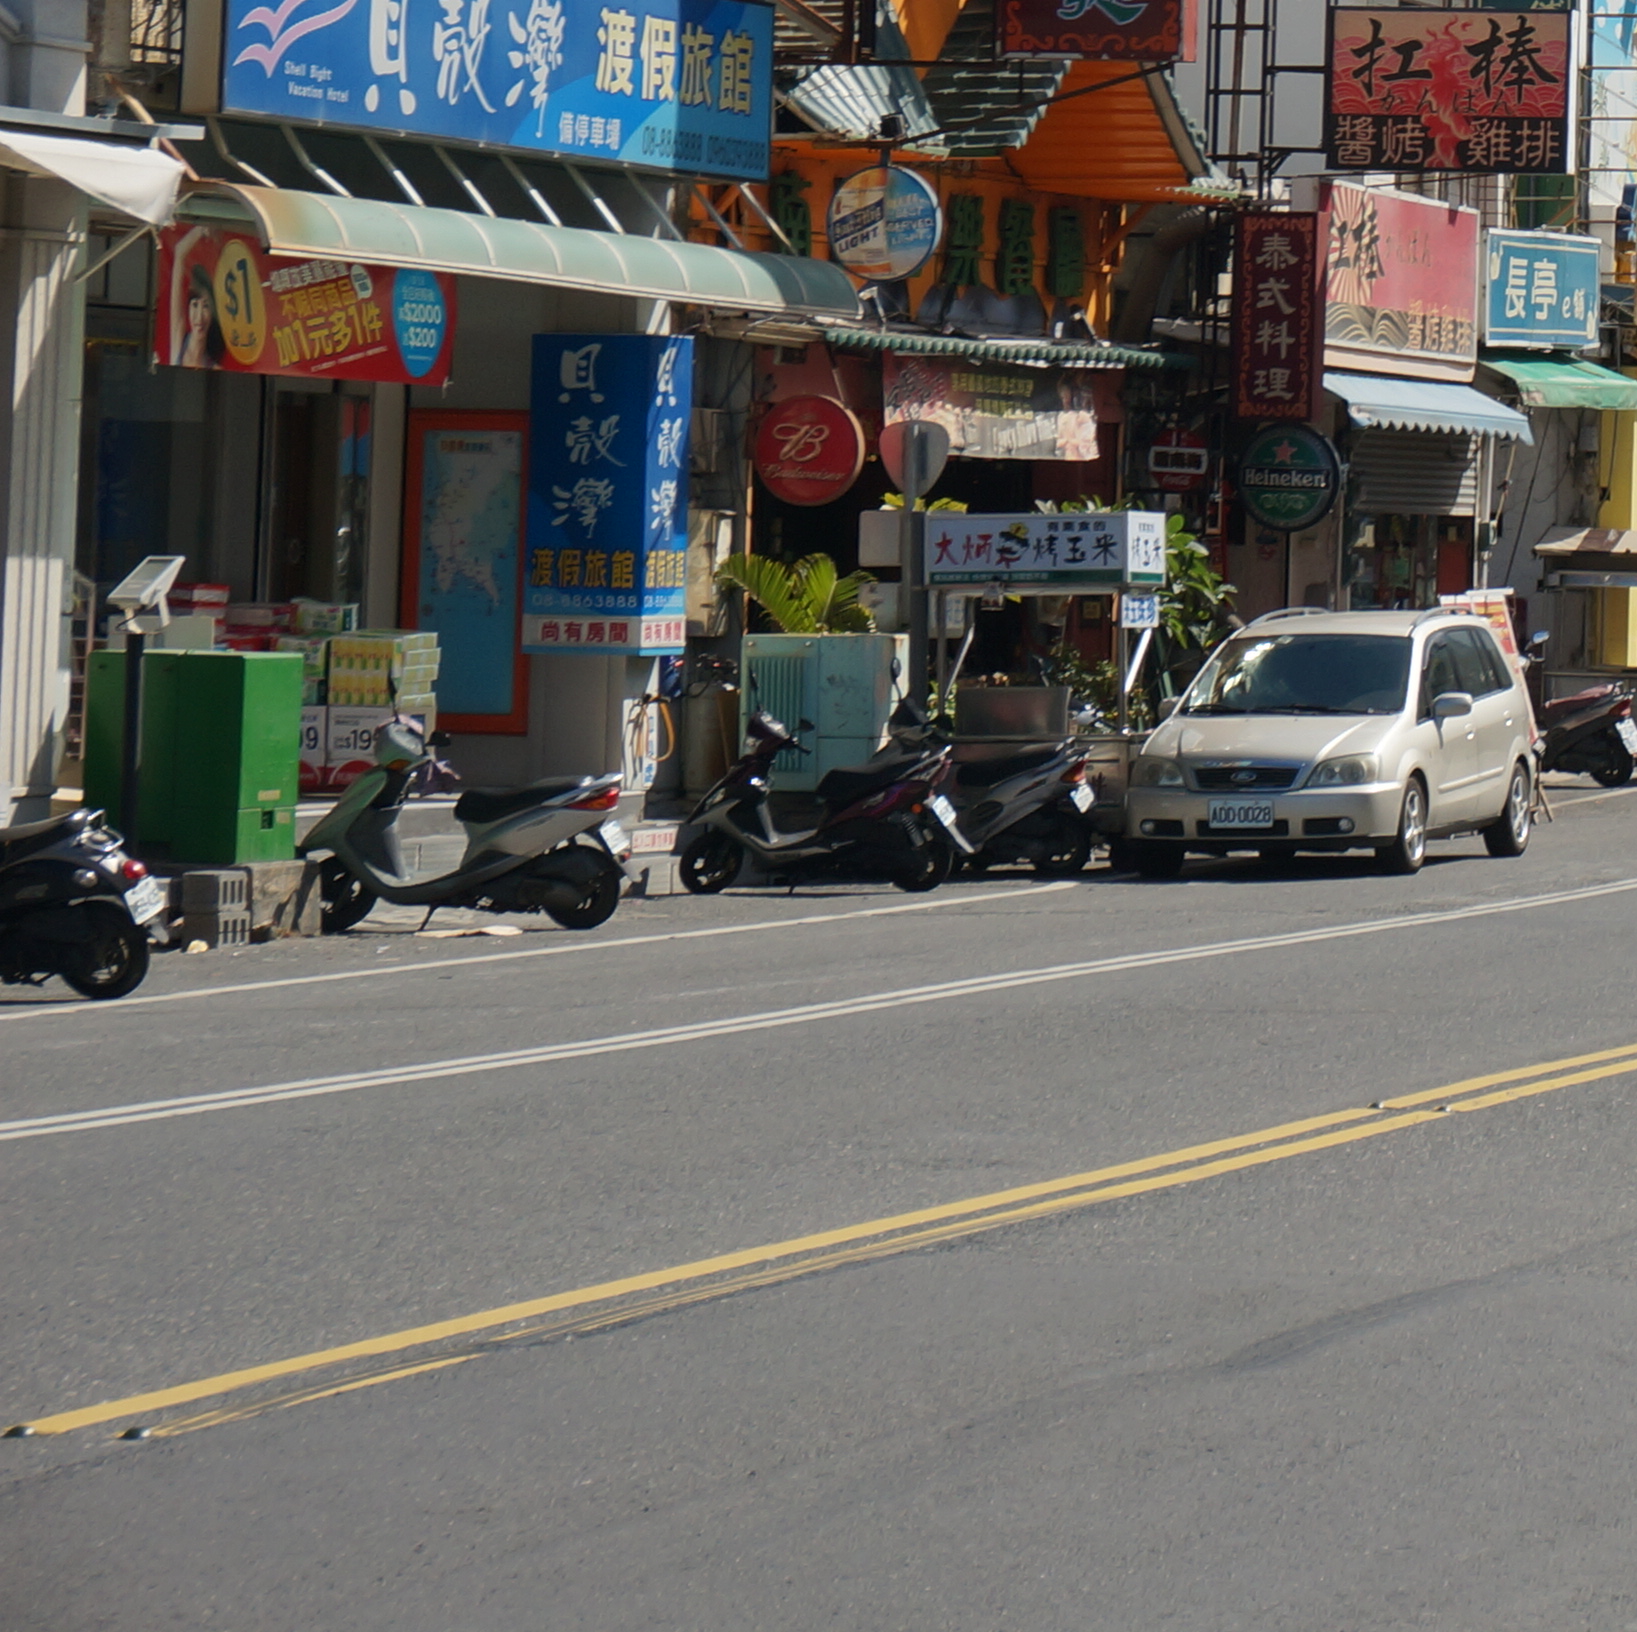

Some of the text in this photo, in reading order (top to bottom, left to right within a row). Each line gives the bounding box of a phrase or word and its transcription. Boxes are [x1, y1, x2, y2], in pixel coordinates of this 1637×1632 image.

[594, 6, 756, 116] 渡假旅館
[1349, 14, 1560, 104] 扛棒
[558, 111, 622, 151] 備停車場
[1335, 114, 1560, 167] 醬烤雞排
[838, 226, 880, 253] LIGHT
[1504, 255, 1559, 320] 長亭
[1253, 231, 1299, 402] 泰式料理
[1245, 467, 1328, 488] Heineken
[529, 548, 637, 590] 渡假旅館
[540, 620, 629, 645] 尚有房間
